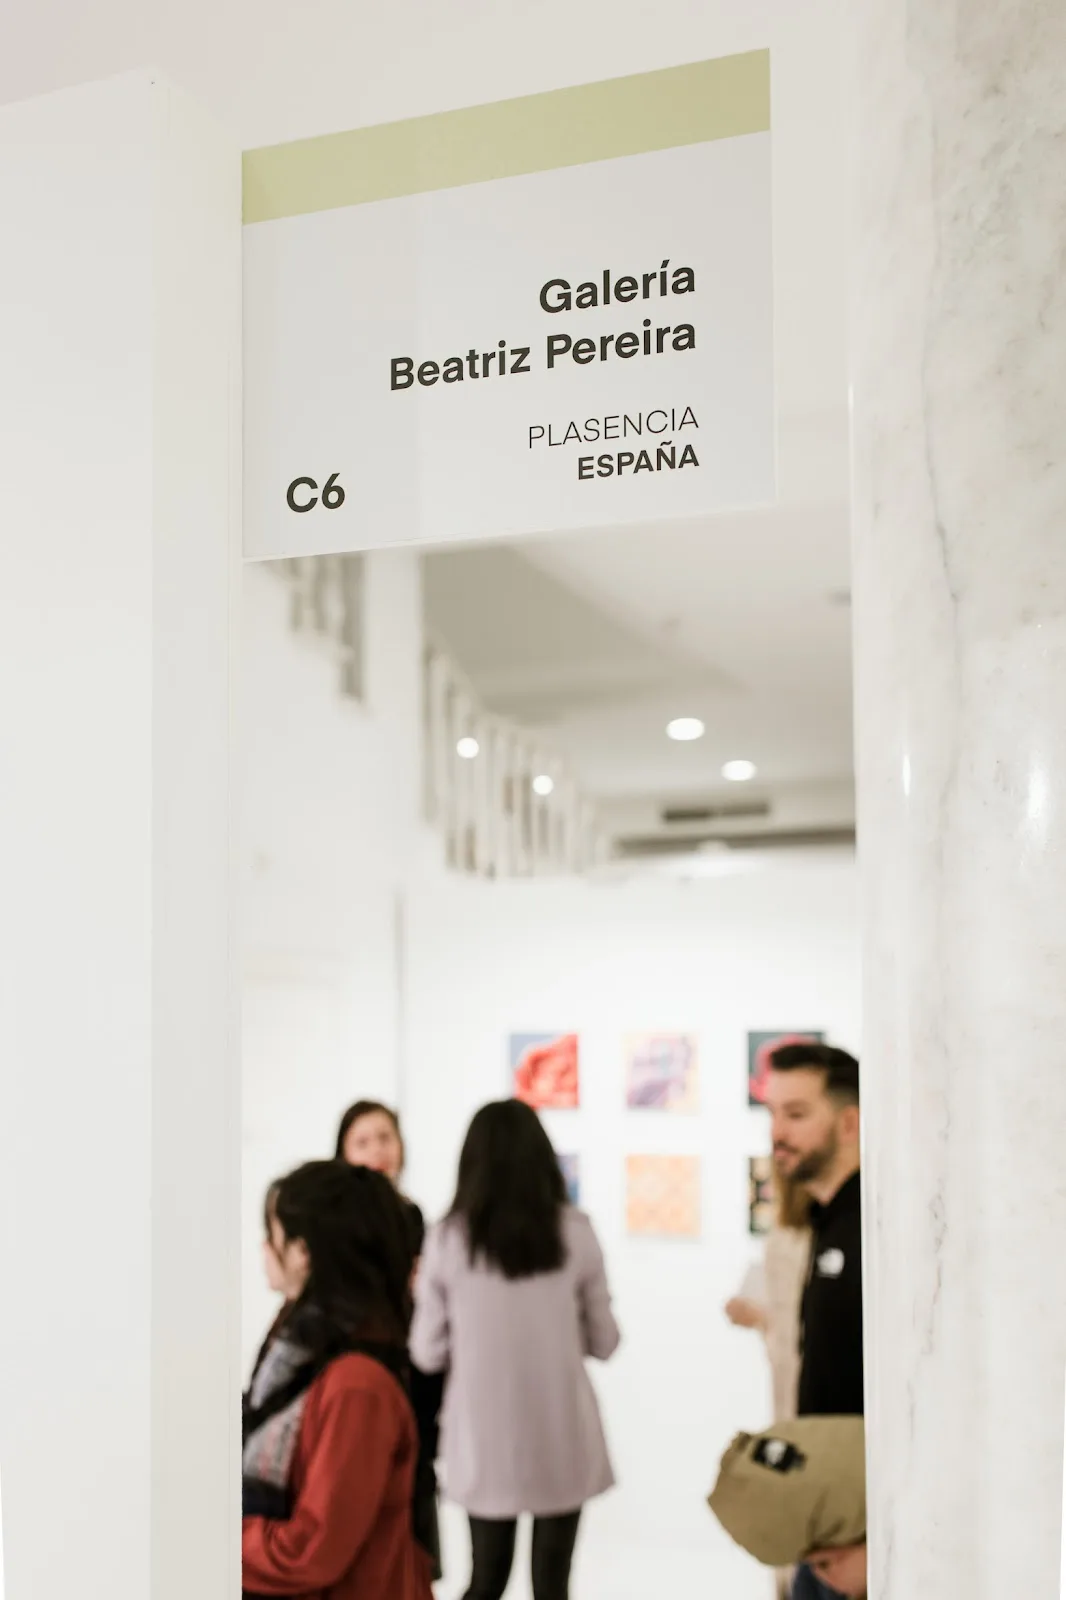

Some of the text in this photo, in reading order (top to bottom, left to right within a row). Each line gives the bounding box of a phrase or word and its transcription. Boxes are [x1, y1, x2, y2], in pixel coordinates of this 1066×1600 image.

[539, 259, 696, 314] Galería
[390, 318, 696, 391] Beatriz Pereira
[528, 406, 700, 450] PLASENCIA
[577, 440, 700, 481] ESPAÑA
[286, 472, 346, 514] C6
